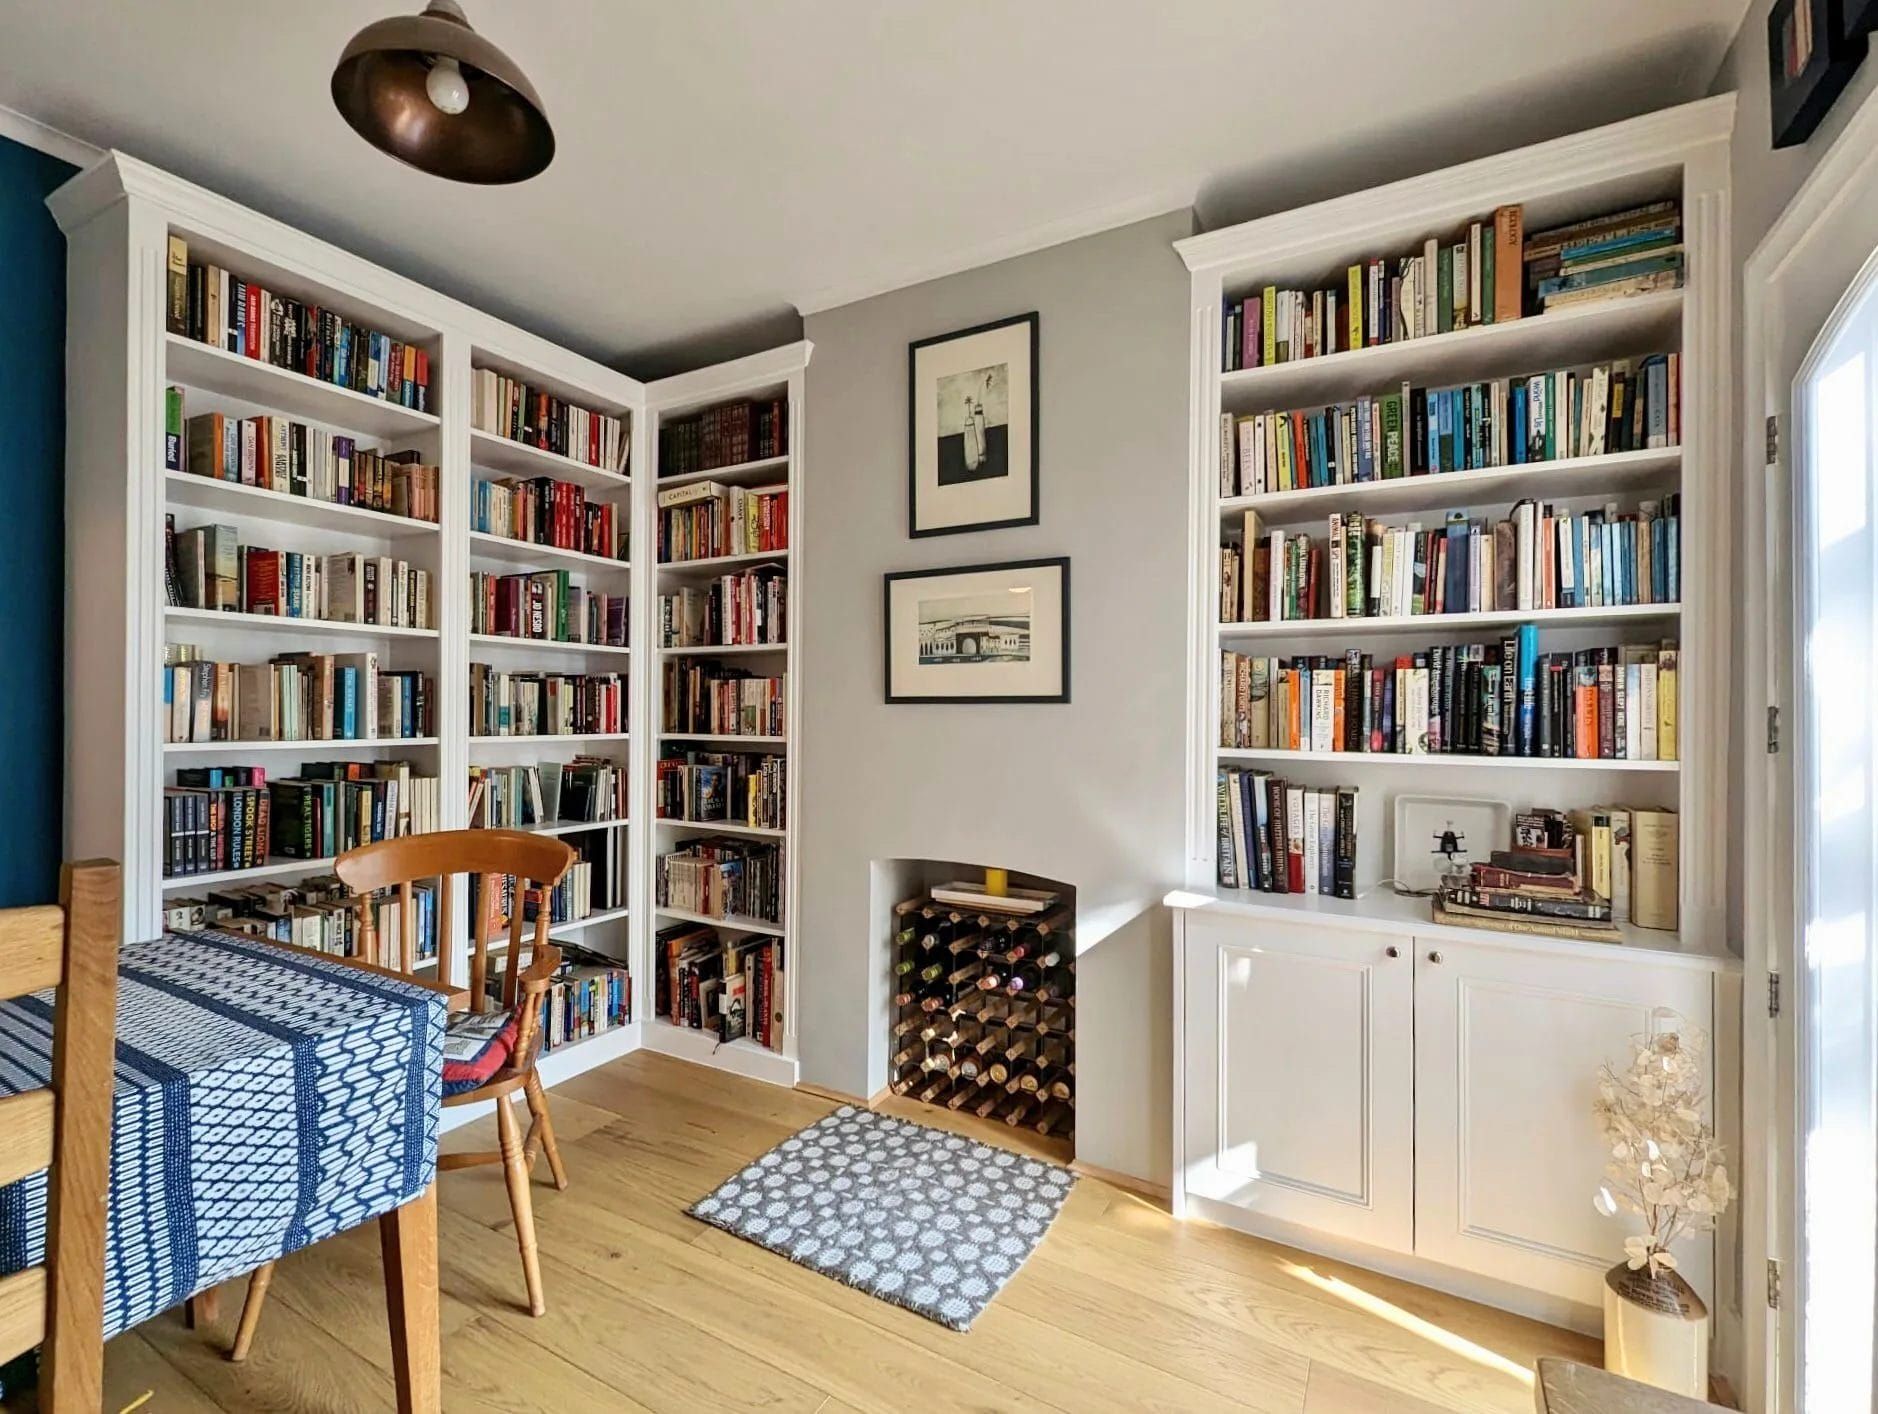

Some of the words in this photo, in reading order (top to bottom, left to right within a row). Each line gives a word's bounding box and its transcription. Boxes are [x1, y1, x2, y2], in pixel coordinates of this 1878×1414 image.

[1386, 400, 1400, 464] GREENPEACE
[168, 435, 177, 462] Buried
[1503, 675, 1515, 703] Earth
[233, 796, 243, 837] LONDON
[246, 796, 256, 827] SPOOK
[258, 798, 269, 826] DEAD
[303, 795, 312, 817] REAL
[1217, 784, 1228, 829] WILDLIFE
[232, 836, 242, 862] RULES
[244, 829, 254, 861] STREET
[256, 826, 265, 855] LIONS
[303, 818, 312, 849] TIGERS
[1222, 836, 1233, 874] BRITAIN
